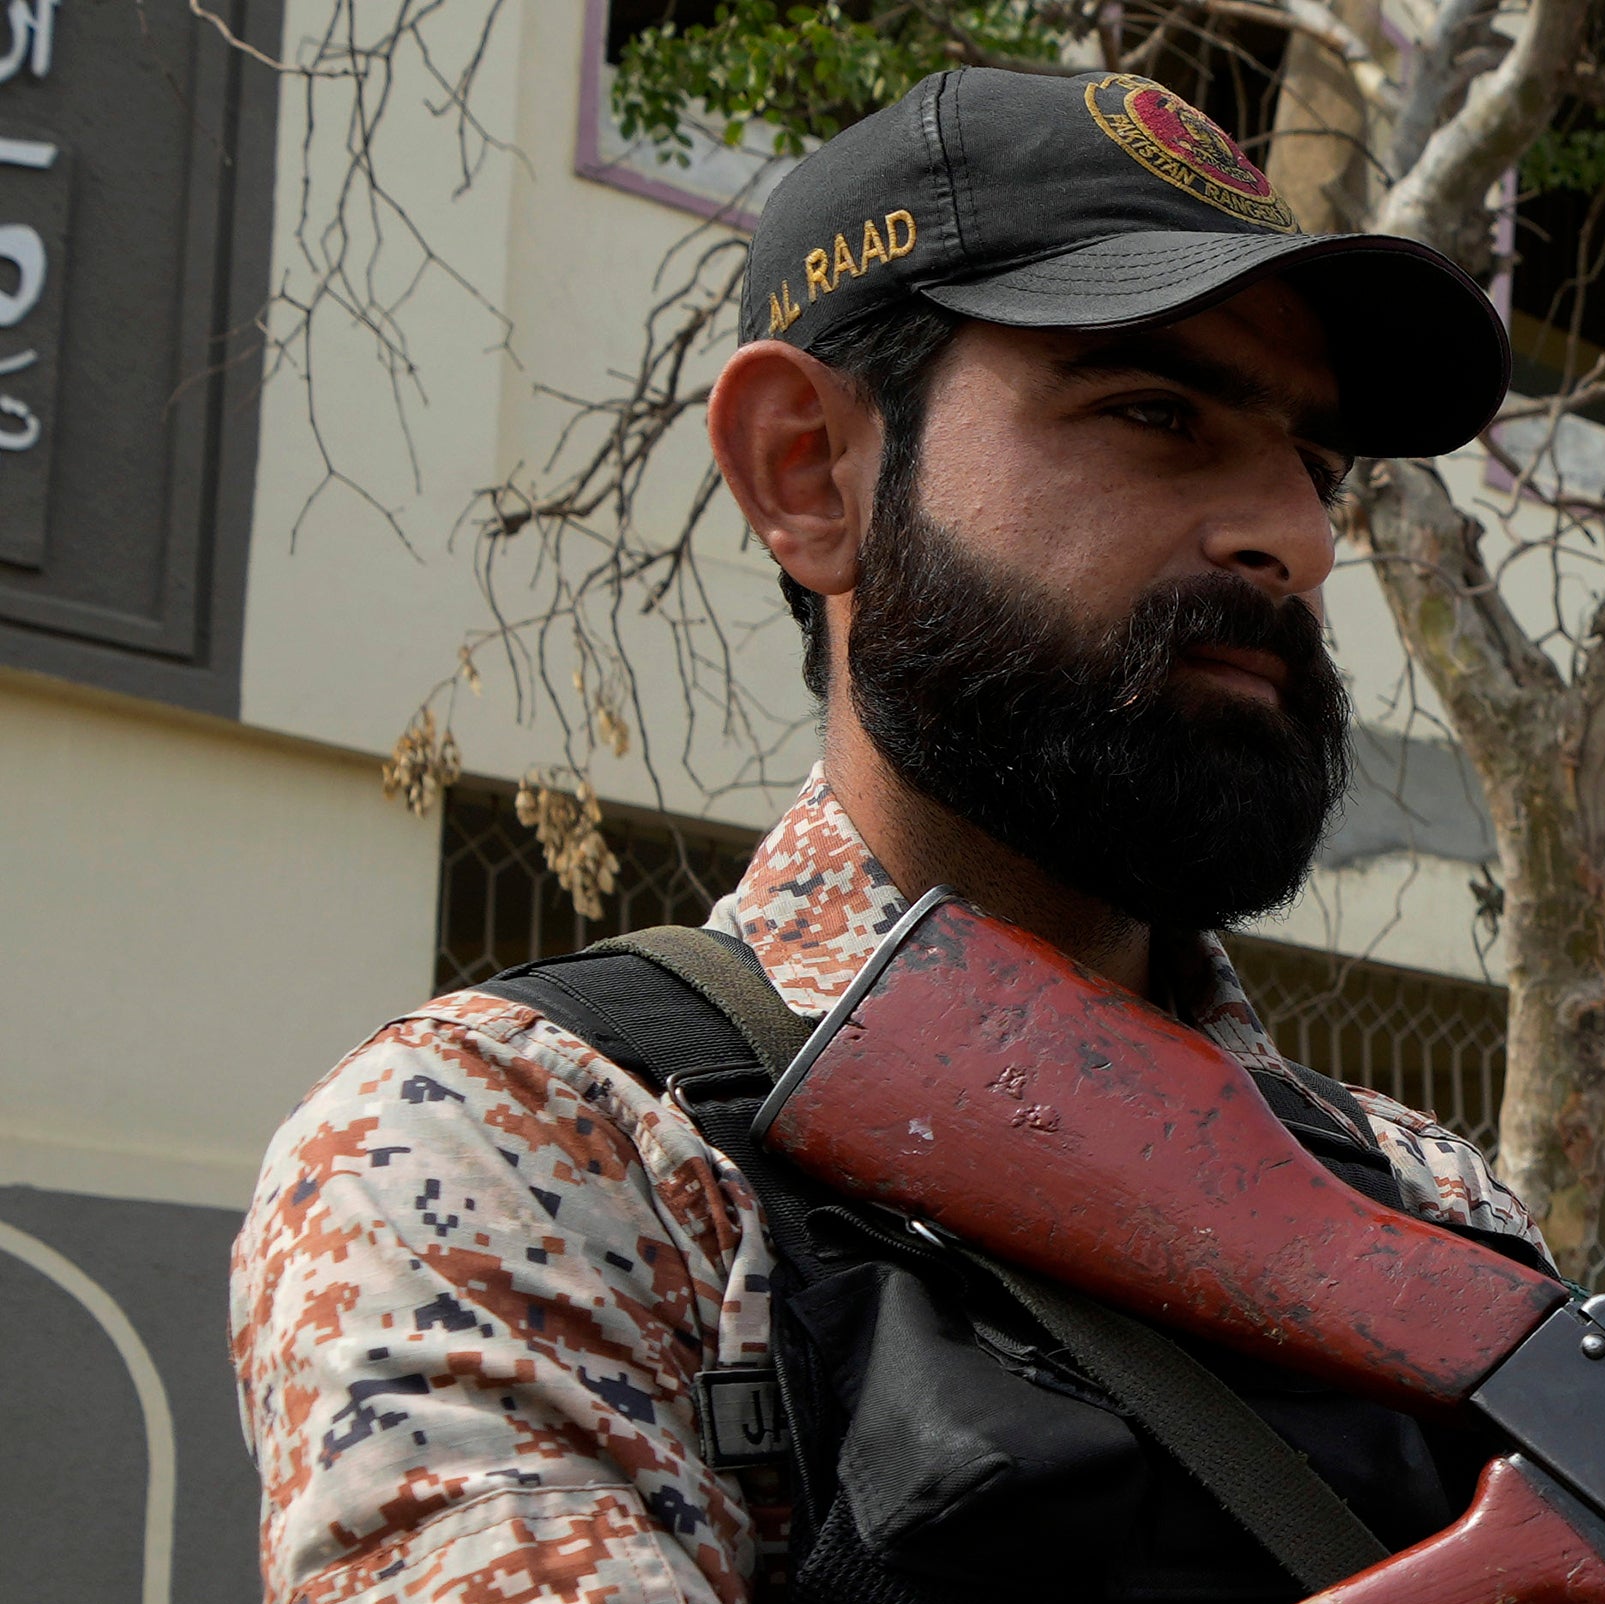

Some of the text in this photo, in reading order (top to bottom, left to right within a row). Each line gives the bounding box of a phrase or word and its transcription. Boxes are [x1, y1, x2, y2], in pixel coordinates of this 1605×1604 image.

[1104, 113, 1198, 187] PAKISTAN
[768, 208, 918, 337] AL RAAD
